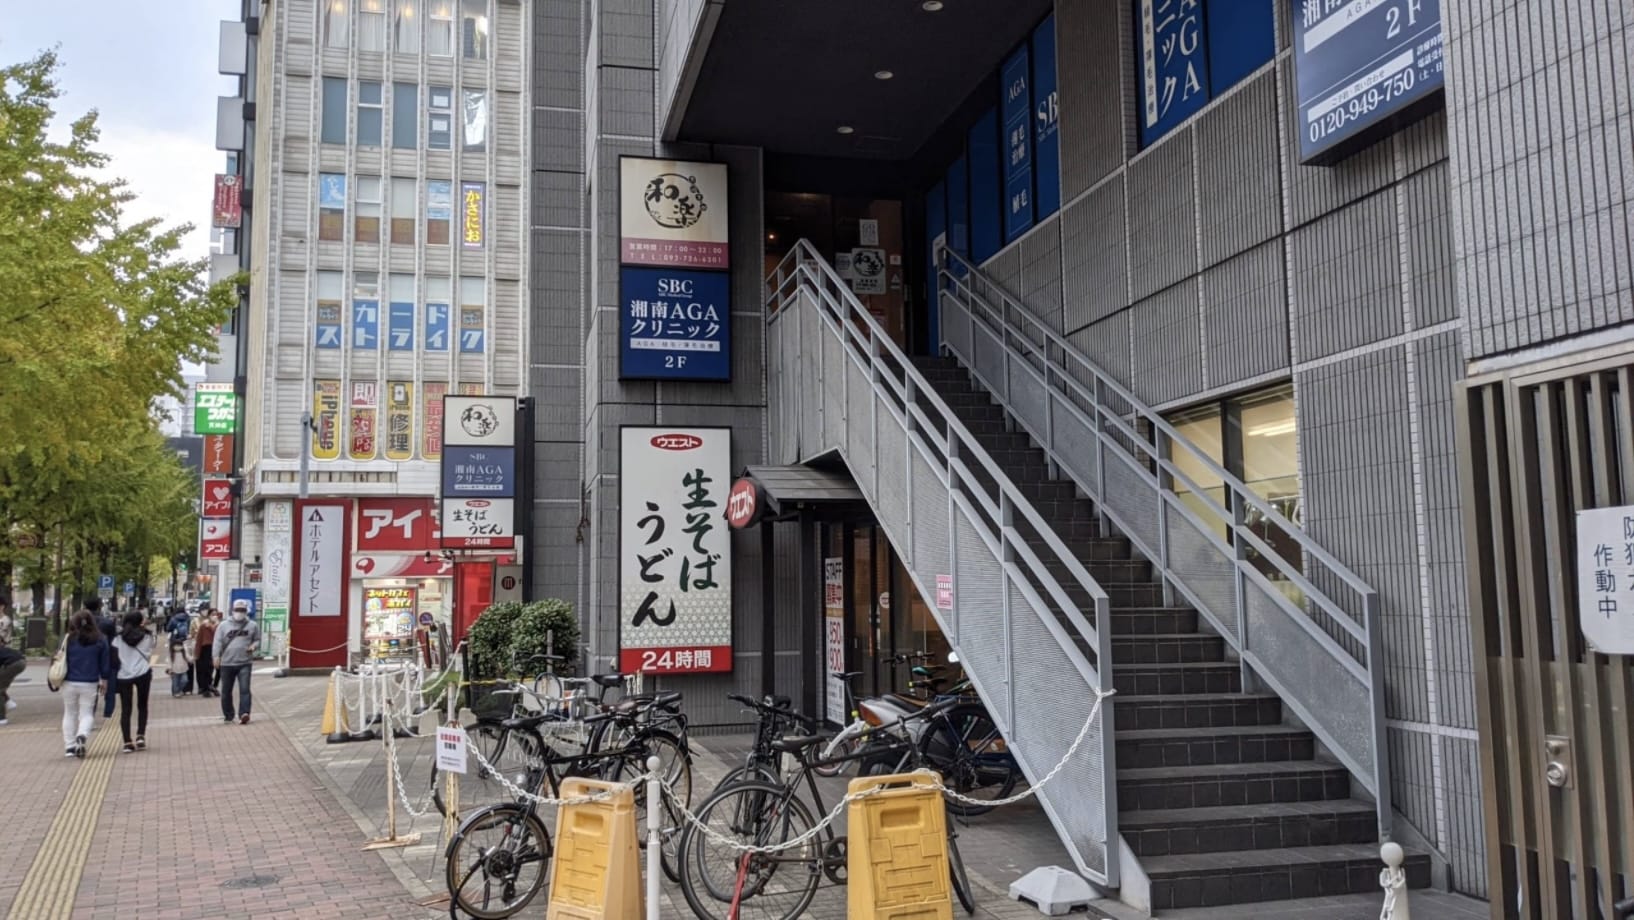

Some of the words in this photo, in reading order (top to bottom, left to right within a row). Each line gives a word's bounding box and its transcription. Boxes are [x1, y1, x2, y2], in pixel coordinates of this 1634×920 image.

[1309, 68, 1415, 143] 0120-949-750
[658, 278, 693, 294] SBC
[630, 300, 720, 321] 湘南AGA
[630, 319, 720, 338] クリニック
[665, 355, 687, 369] 2F
[389, 413, 409, 452] 修理
[656, 436, 699, 448] ウエスト
[730, 488, 754, 520] ウエスト
[452, 508, 489, 522] 生そば
[468, 521, 503, 536] うどん
[679, 468, 721, 592] 生そば
[308, 523, 323, 614] ホテルアセント
[631, 501, 677, 627] うどん
[102, 576, 112, 587] P
[1593, 543, 1618, 619] 作動中
[641, 650, 712, 671] 24時間
